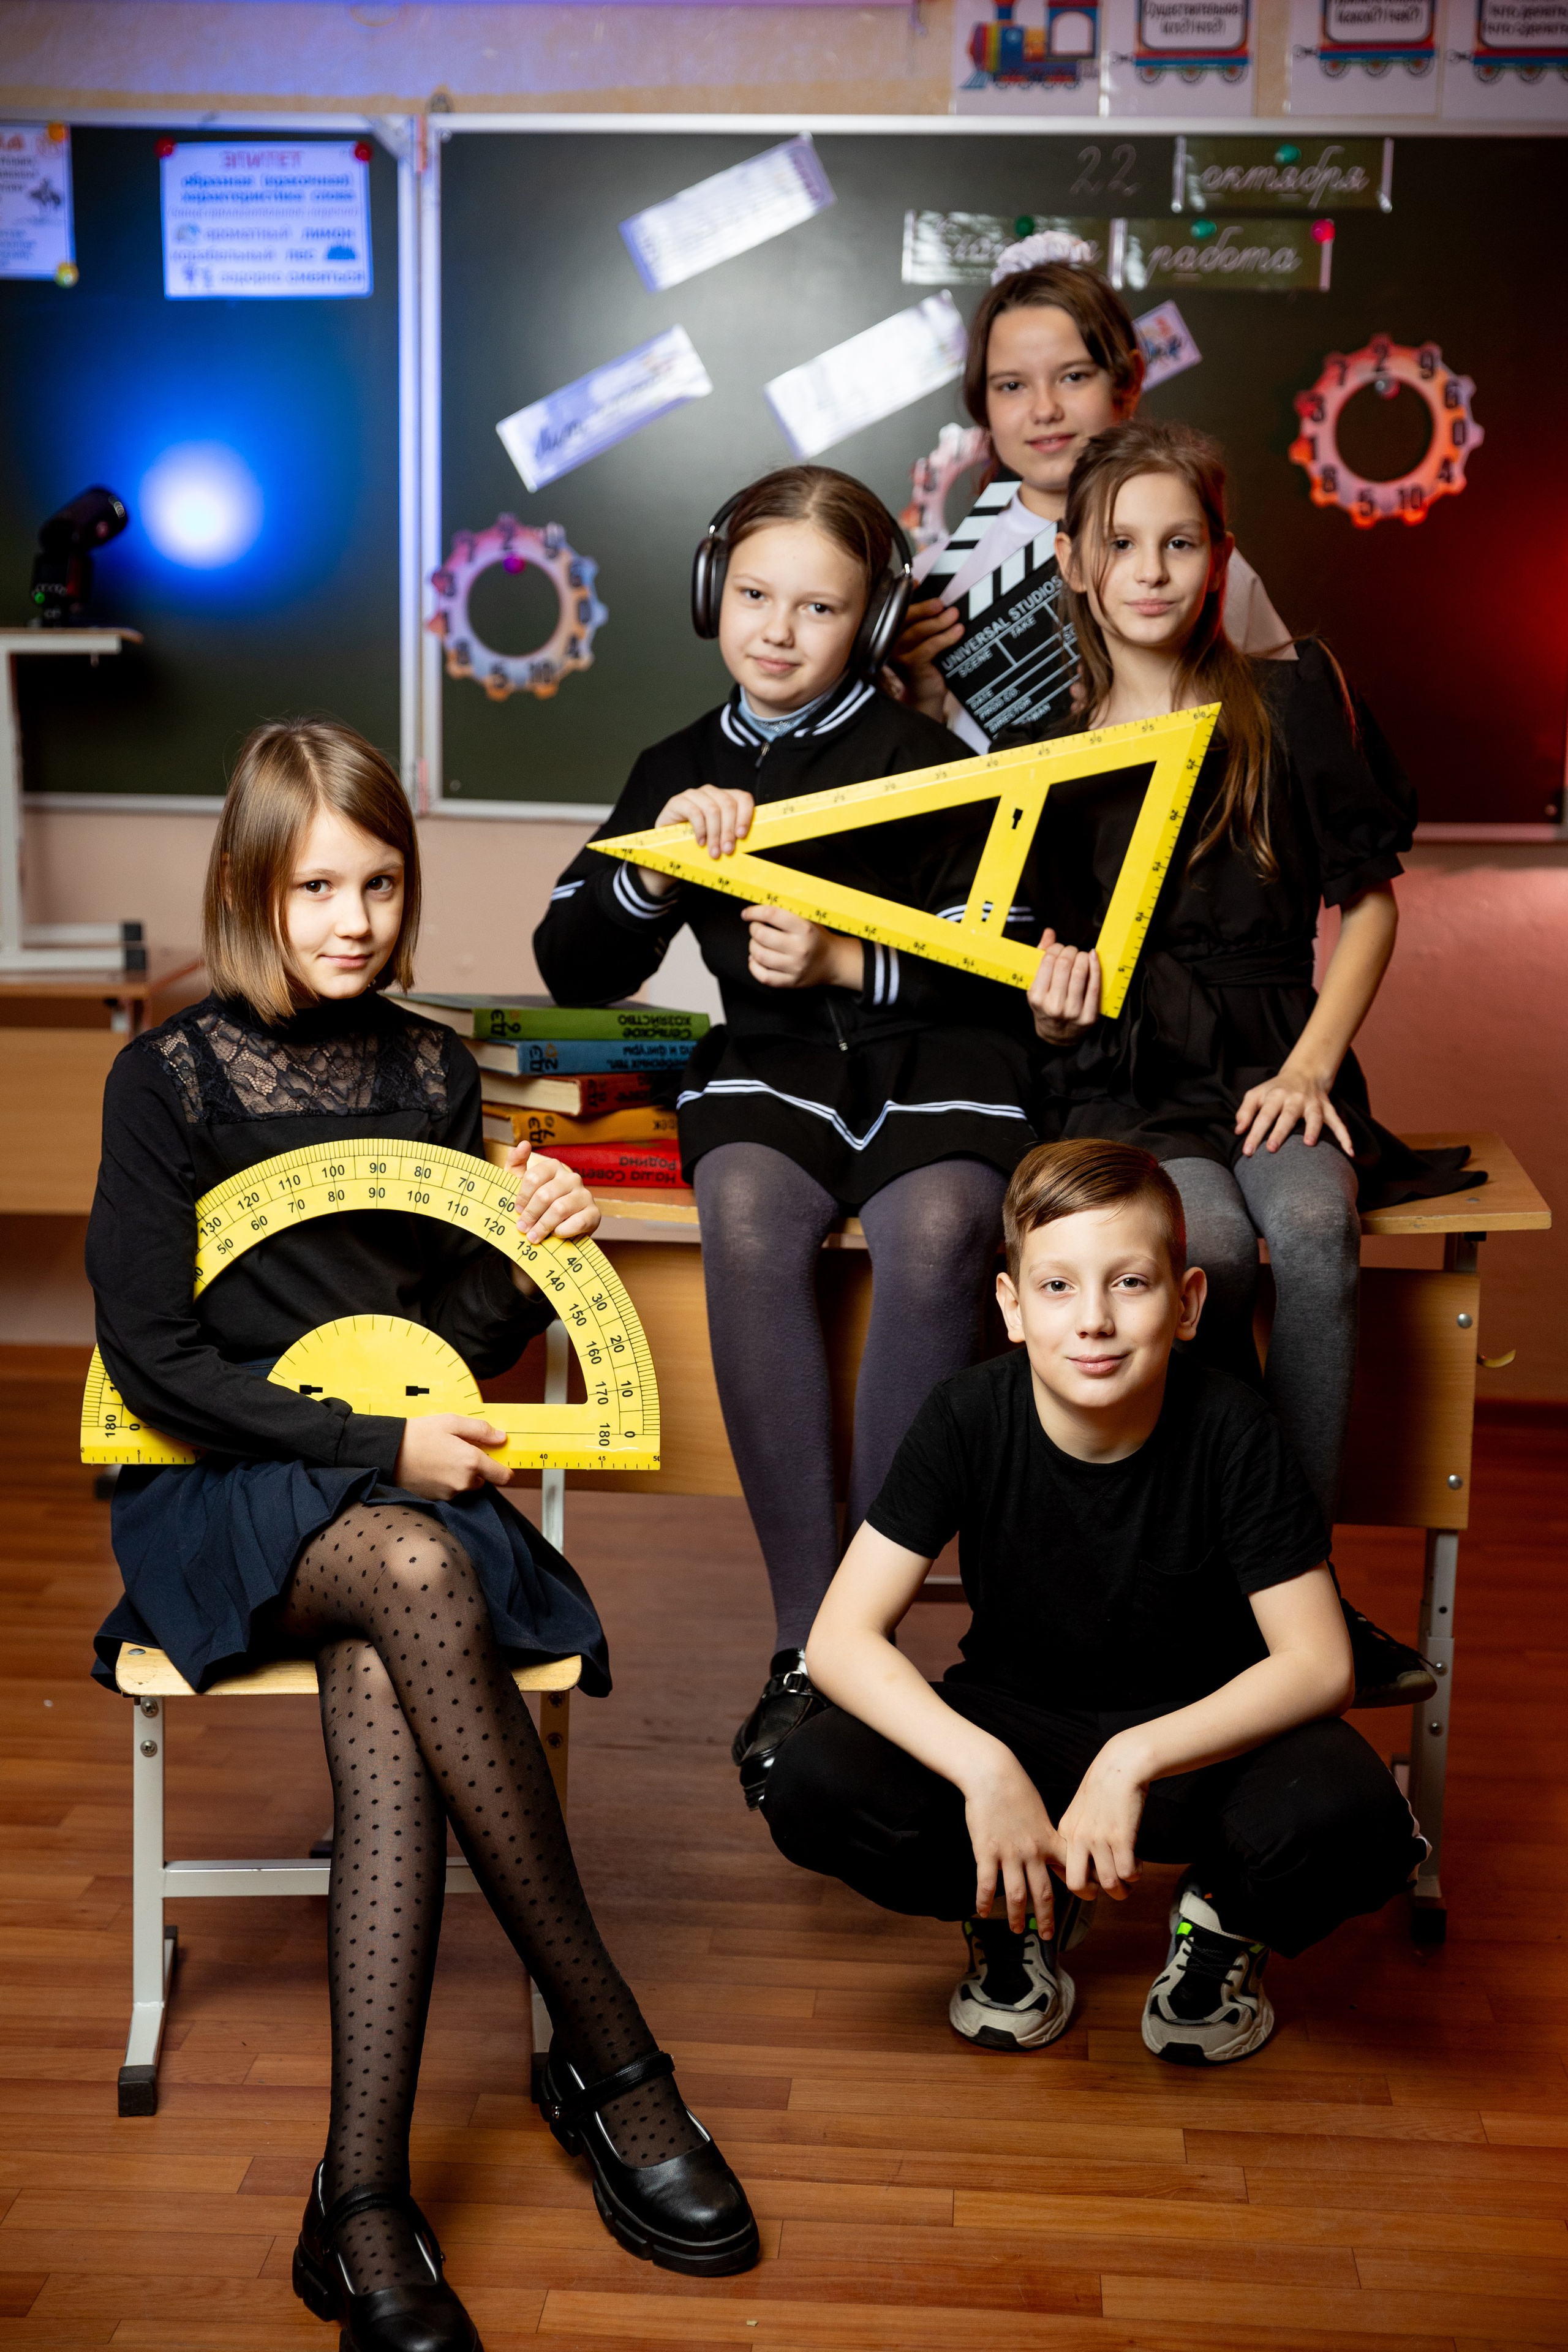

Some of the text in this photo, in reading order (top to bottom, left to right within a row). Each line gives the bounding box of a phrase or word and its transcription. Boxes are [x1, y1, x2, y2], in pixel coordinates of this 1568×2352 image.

[1199, 145, 1371, 209] октября
[1145, 225, 1303, 284] работа
[941, 575, 1063, 671] UNIVERSAL STUDIOS
[1011, 614, 1037, 639] TAKE
[958, 647, 993, 679] SCENE
[970, 688, 995, 710] DATE
[989, 697, 1033, 734] DIRECTOR
[622, 1027, 692, 1040] Сельское
[622, 1044, 668, 1057] фигуры
[322, 1164, 345, 1178] 100
[369, 1162, 386, 1174] 90
[620, 1156, 677, 1171] Родина
[414, 1166, 431, 1179] 80
[630, 1170, 676, 1185] Наша
[279, 1175, 301, 1191] 110
[458, 1177, 476, 1193] 70
[237, 1192, 260, 1210] 120
[328, 1189, 345, 1202] 80
[368, 1186, 386, 1199] 90
[407, 1190, 430, 1205] 100
[288, 1199, 306, 1213] 70
[447, 1200, 469, 1217] 110
[497, 1196, 515, 1213] 60
[200, 1216, 222, 1237] 130
[251, 1215, 268, 1231] 60
[484, 1216, 506, 1237] 120
[217, 1238, 234, 1255] 50
[516, 1240, 538, 1261] 130
[566, 1256, 583, 1273] 40
[545, 1269, 566, 1292] 140
[592, 1292, 608, 1311] 30
[568, 1303, 587, 1327] 150
[586, 1341, 603, 1365] 160
[609, 1335, 625, 1354] 20
[595, 1381, 609, 1406] 170
[620, 1380, 634, 1398] 10
[105, 1414, 117, 1438] 180
[129, 1423, 141, 1431] 0
[598, 1422, 611, 1447] 180
[624, 1430, 636, 1439] 0
